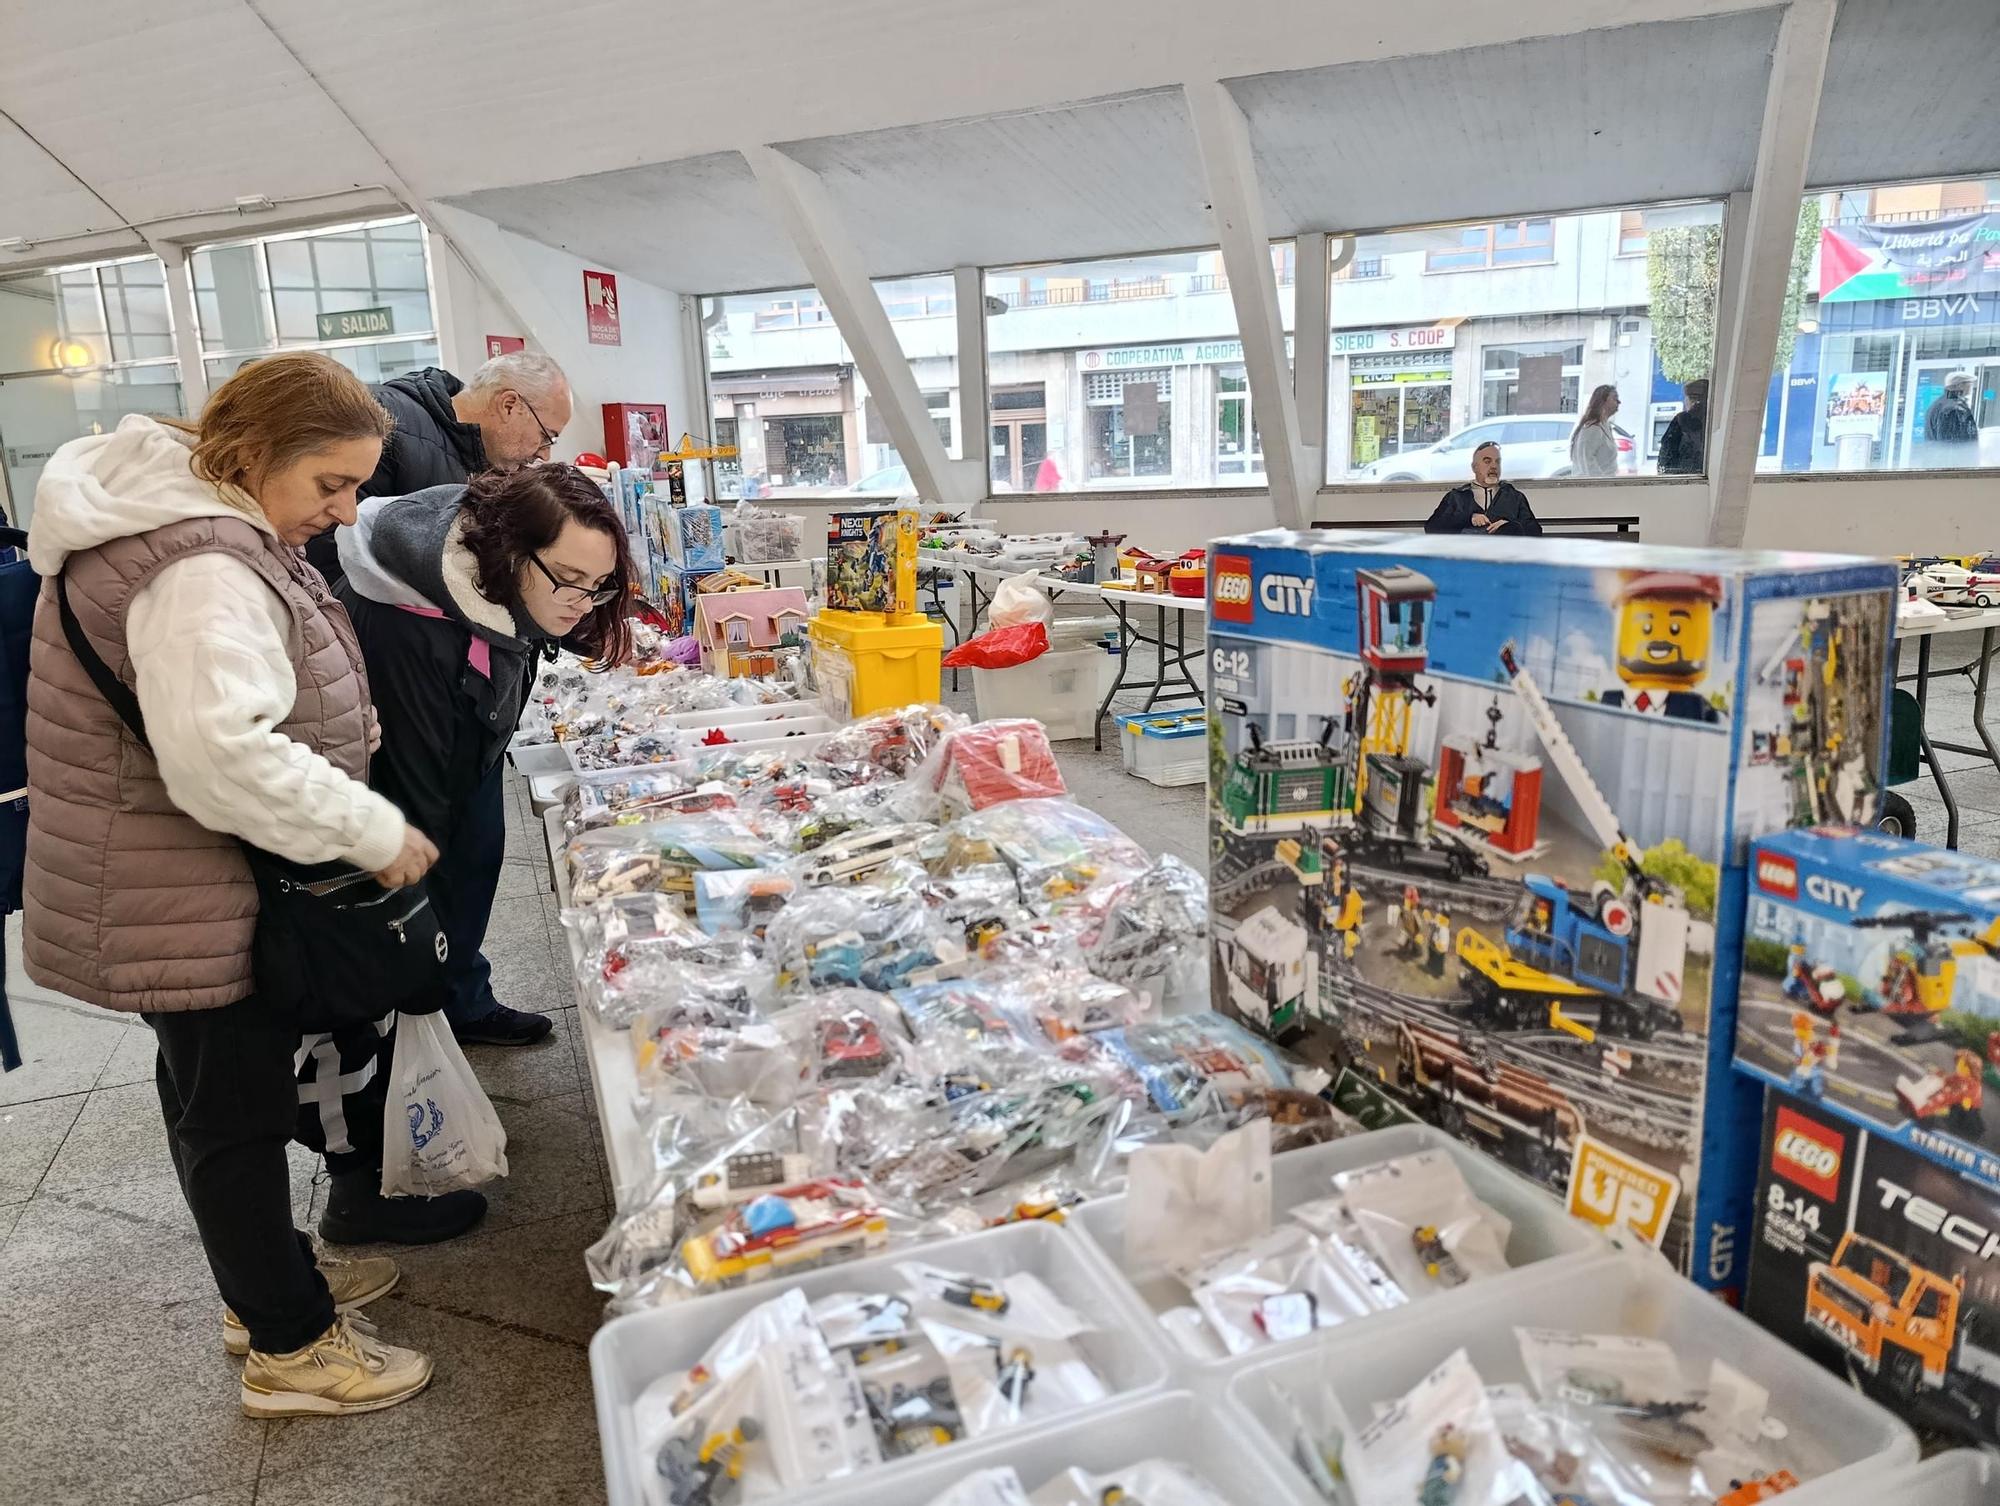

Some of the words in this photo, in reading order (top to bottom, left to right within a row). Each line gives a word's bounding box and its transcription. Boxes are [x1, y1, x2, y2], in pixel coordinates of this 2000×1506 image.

[1902, 294, 1980, 320] BBVA
[341, 313, 389, 335] SALIDA
[1106, 347, 1185, 366] COOPERATIVA
[1335, 334, 1374, 351] SIERO
[1790, 377, 1816, 387] BBVA
[841, 517, 863, 528] NEXO
[1215, 573, 1251, 603] LEGO
[1259, 573, 1315, 617] CITY
[1212, 648, 1250, 678] 6-12
[1804, 874, 1865, 912] CITY
[1777, 1130, 1838, 1176] LEGO
[1767, 1183, 1821, 1231] 8-14
[1709, 1220, 1736, 1281] CITY
